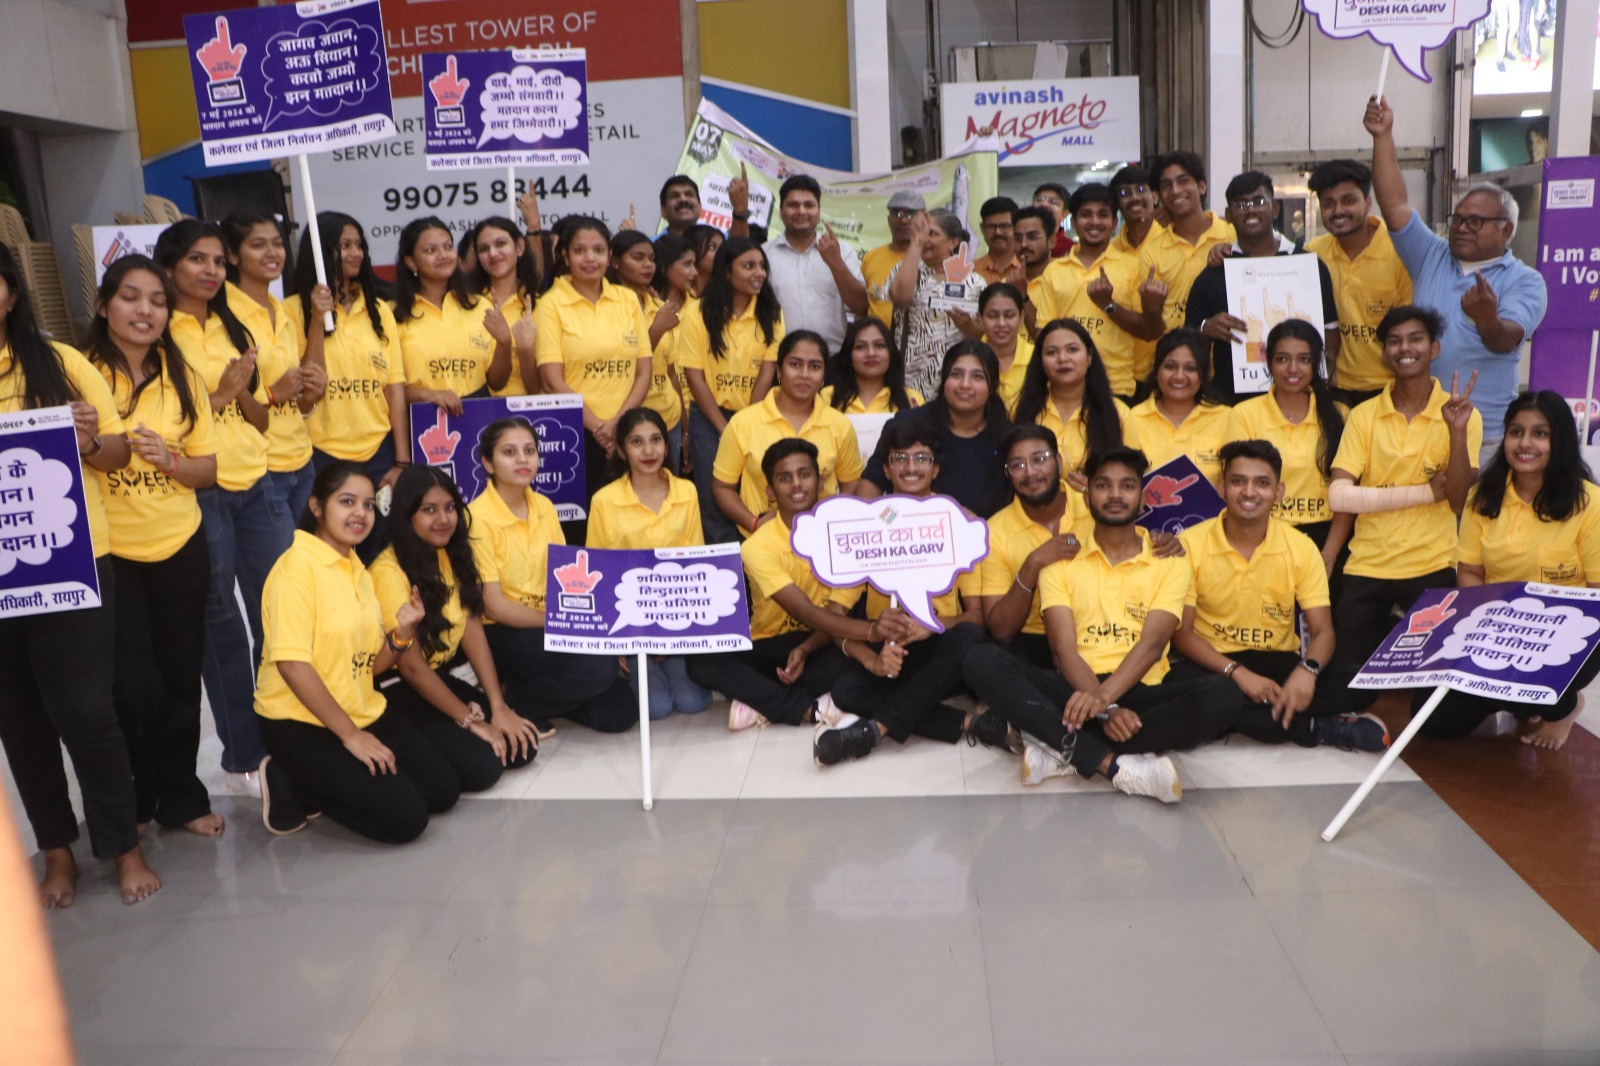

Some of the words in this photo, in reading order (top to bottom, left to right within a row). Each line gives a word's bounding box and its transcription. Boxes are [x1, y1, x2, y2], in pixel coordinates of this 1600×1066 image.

[1359, 5, 1390, 16] DESH
[1392, 4, 1409, 14] KA
[1411, 3, 1446, 13] GARV
[465, 15, 555, 40] TOWER
[563, 11, 597, 32] OF
[974, 85, 1063, 106] avinash
[497, 104, 530, 115] मतदान
[695, 122, 721, 144] 07
[965, 93, 1107, 155] Magneto
[261, 134, 286, 149] जिला
[1061, 135, 1094, 146] MALL
[332, 143, 415, 162] SERVICE
[383, 182, 480, 212] 99075
[1543, 244, 1549, 262] I
[1553, 248, 1584, 262] am
[1561, 266, 1568, 284] I
[834, 530, 884, 555] चुनाव
[888, 526, 914, 543] का
[917, 518, 946, 540] पर्व
[855, 546, 888, 560] DESH
[890, 545, 908, 557] KA
[909, 542, 945, 555] GARV
[51, 589, 87, 606] रायपुर
[1485, 605, 1568, 626] शक्तिशाली
[1462, 645, 1532, 666] मतदान।।
[1518, 688, 1551, 700] रायपुर
